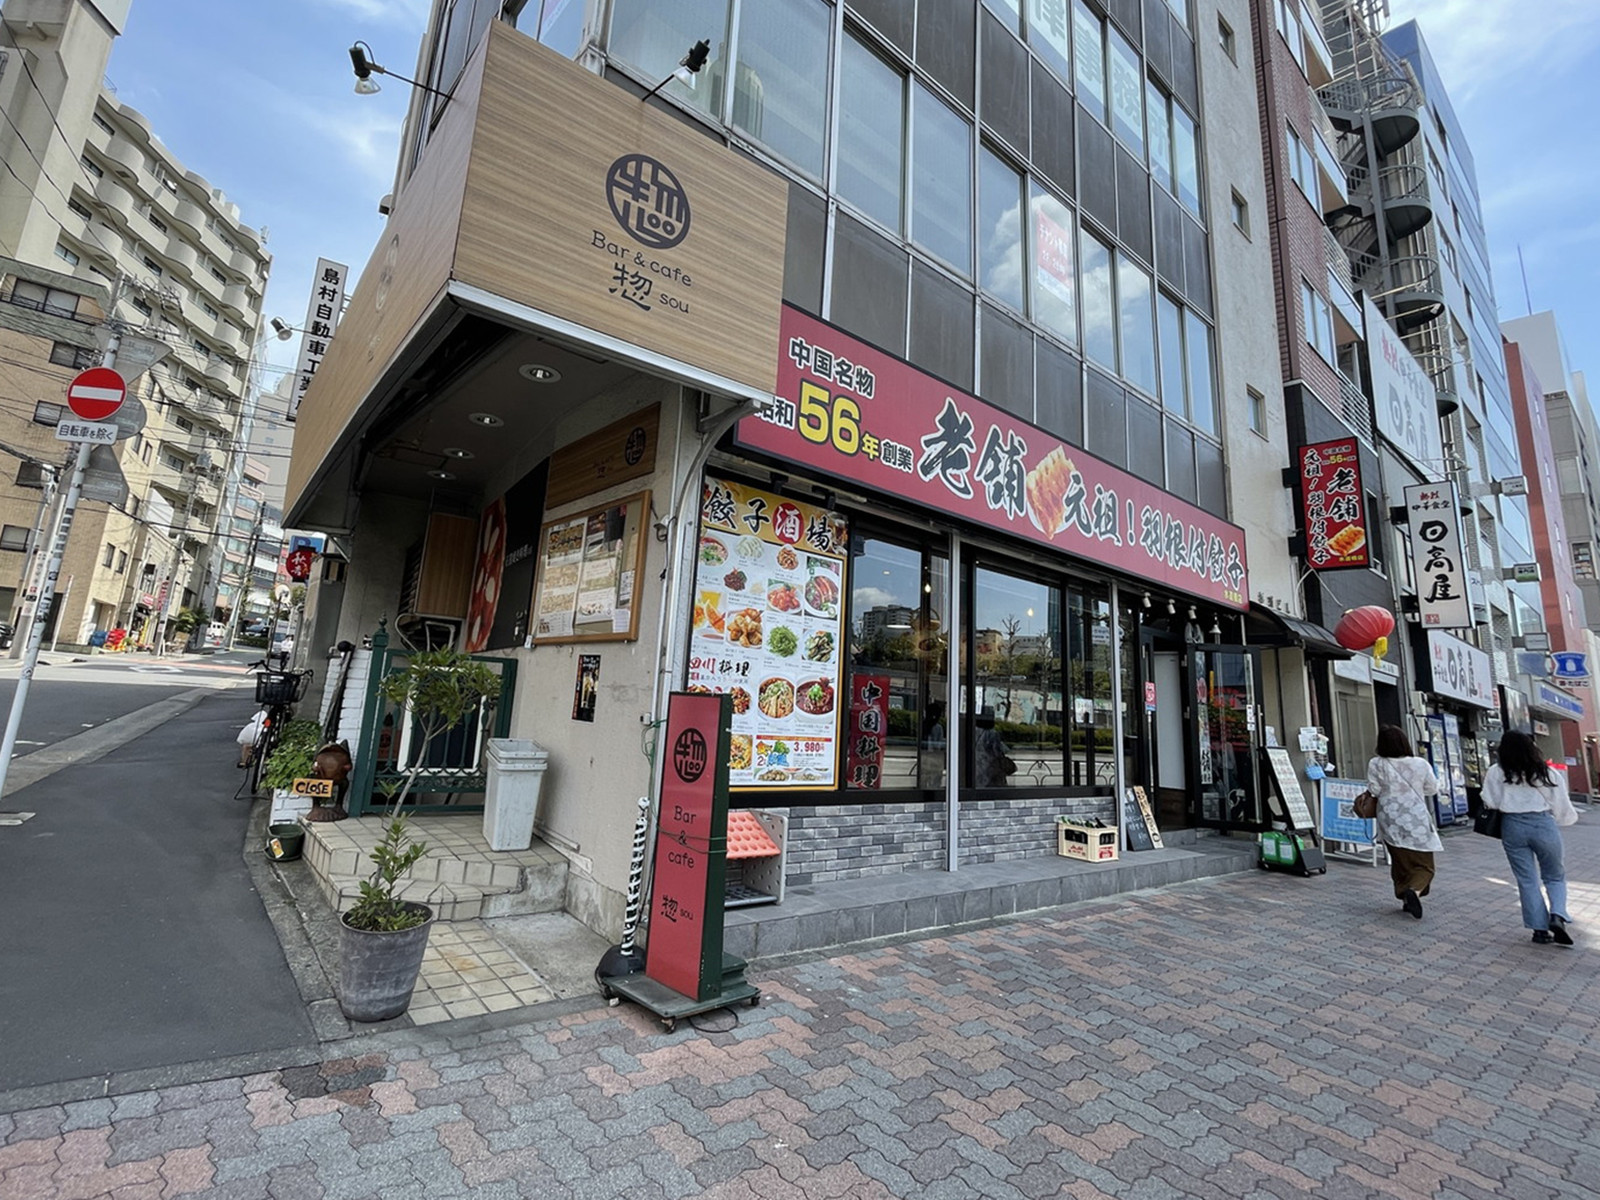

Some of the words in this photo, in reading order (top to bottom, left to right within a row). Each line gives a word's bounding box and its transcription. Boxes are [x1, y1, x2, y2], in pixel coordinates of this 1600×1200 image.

[591, 230, 630, 259] Bar
[633, 252, 646, 268] &
[650, 260, 692, 287] cafe
[608, 262, 653, 312] 惣
[659, 293, 690, 314] sou
[295, 267, 334, 410] 島村自動車工業
[789, 338, 875, 399] 中国名物
[58, 424, 114, 442] 自転車を除く
[917, 397, 1028, 520] 老舗
[704, 486, 832, 551] 餃子酒場
[1419, 520, 1461, 603] 日高屋
[853, 680, 882, 788] 中国料理
[295, 781, 329, 795] CLOSE
[673, 805, 697, 825] Bar
[668, 852, 695, 869] cafe
[678, 830, 688, 846] &
[680, 908, 694, 921] sou
